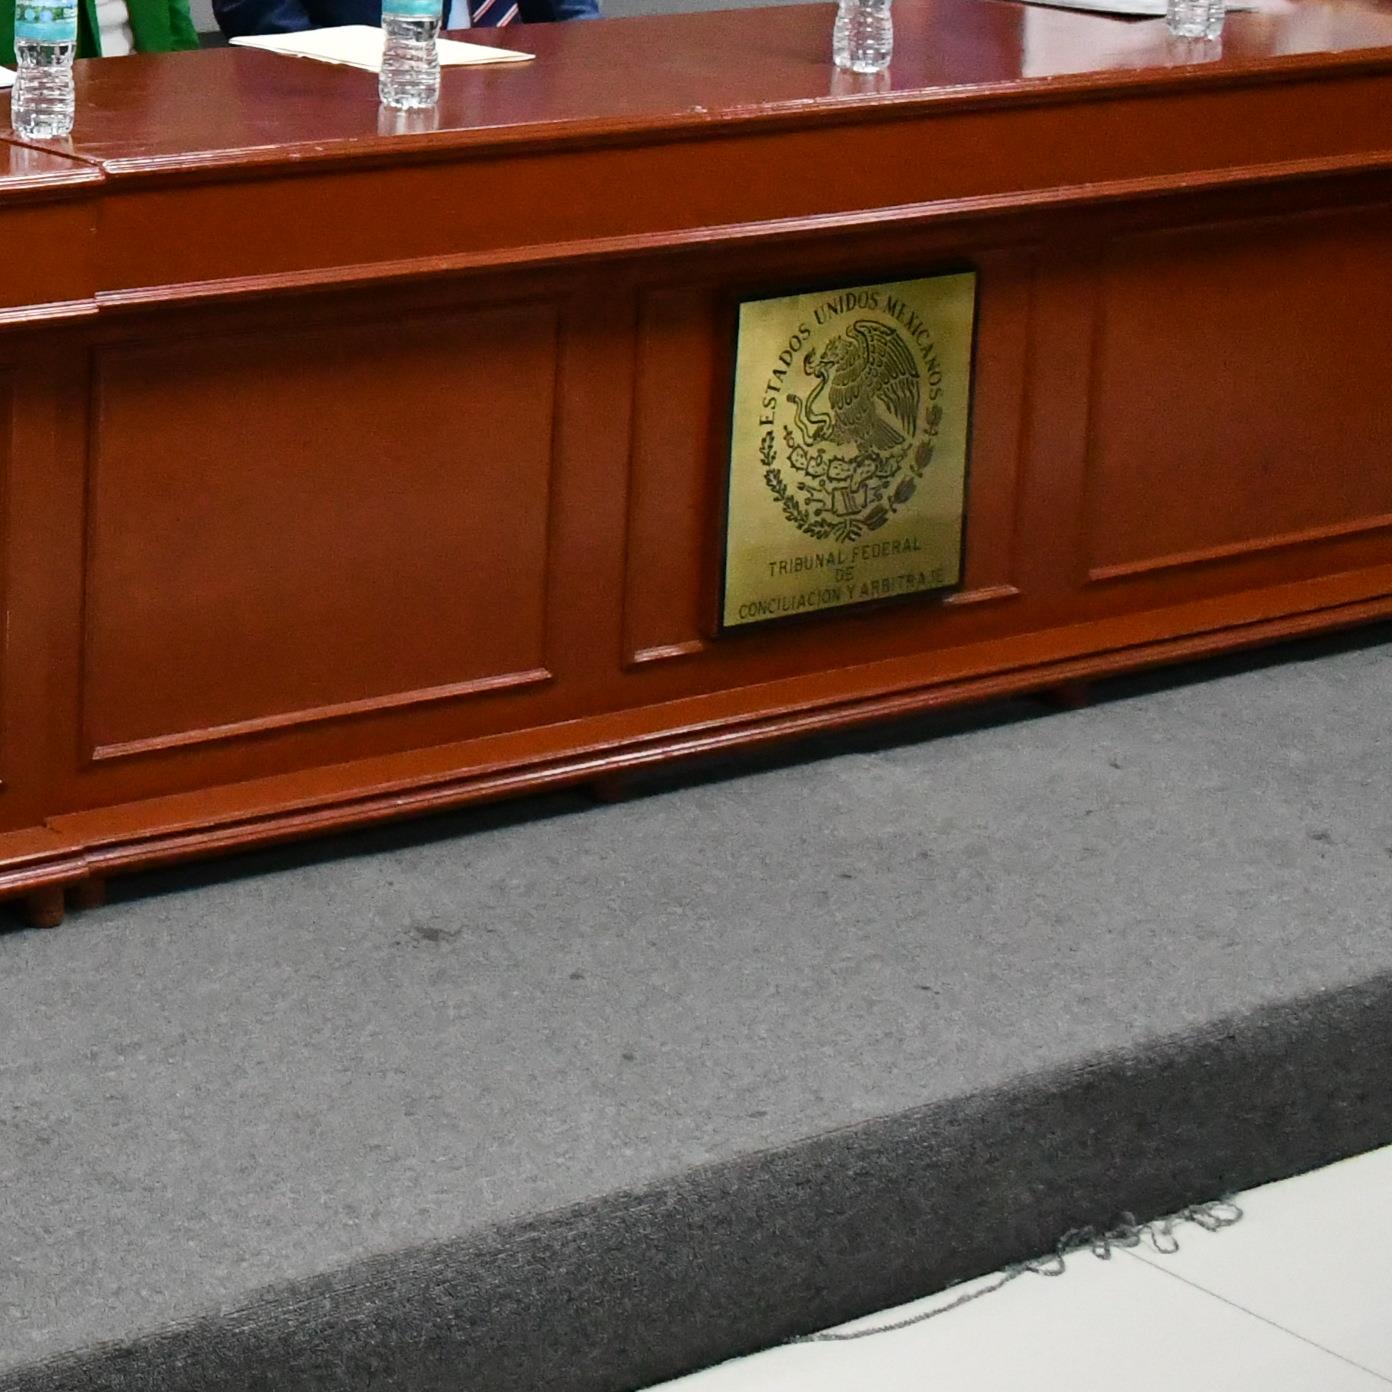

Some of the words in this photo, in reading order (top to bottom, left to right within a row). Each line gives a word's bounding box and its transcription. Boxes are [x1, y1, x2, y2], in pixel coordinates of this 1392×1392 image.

[759, 323, 811, 427] ESTADOS
[814, 291, 879, 325] UNIDOS
[883, 295, 943, 401] MEXICANOS
[769, 551, 844, 577] TRIBUNAL
[851, 537, 923, 563] FEDERAL
[834, 565, 855, 583] DE
[846, 584, 856, 601] Y
